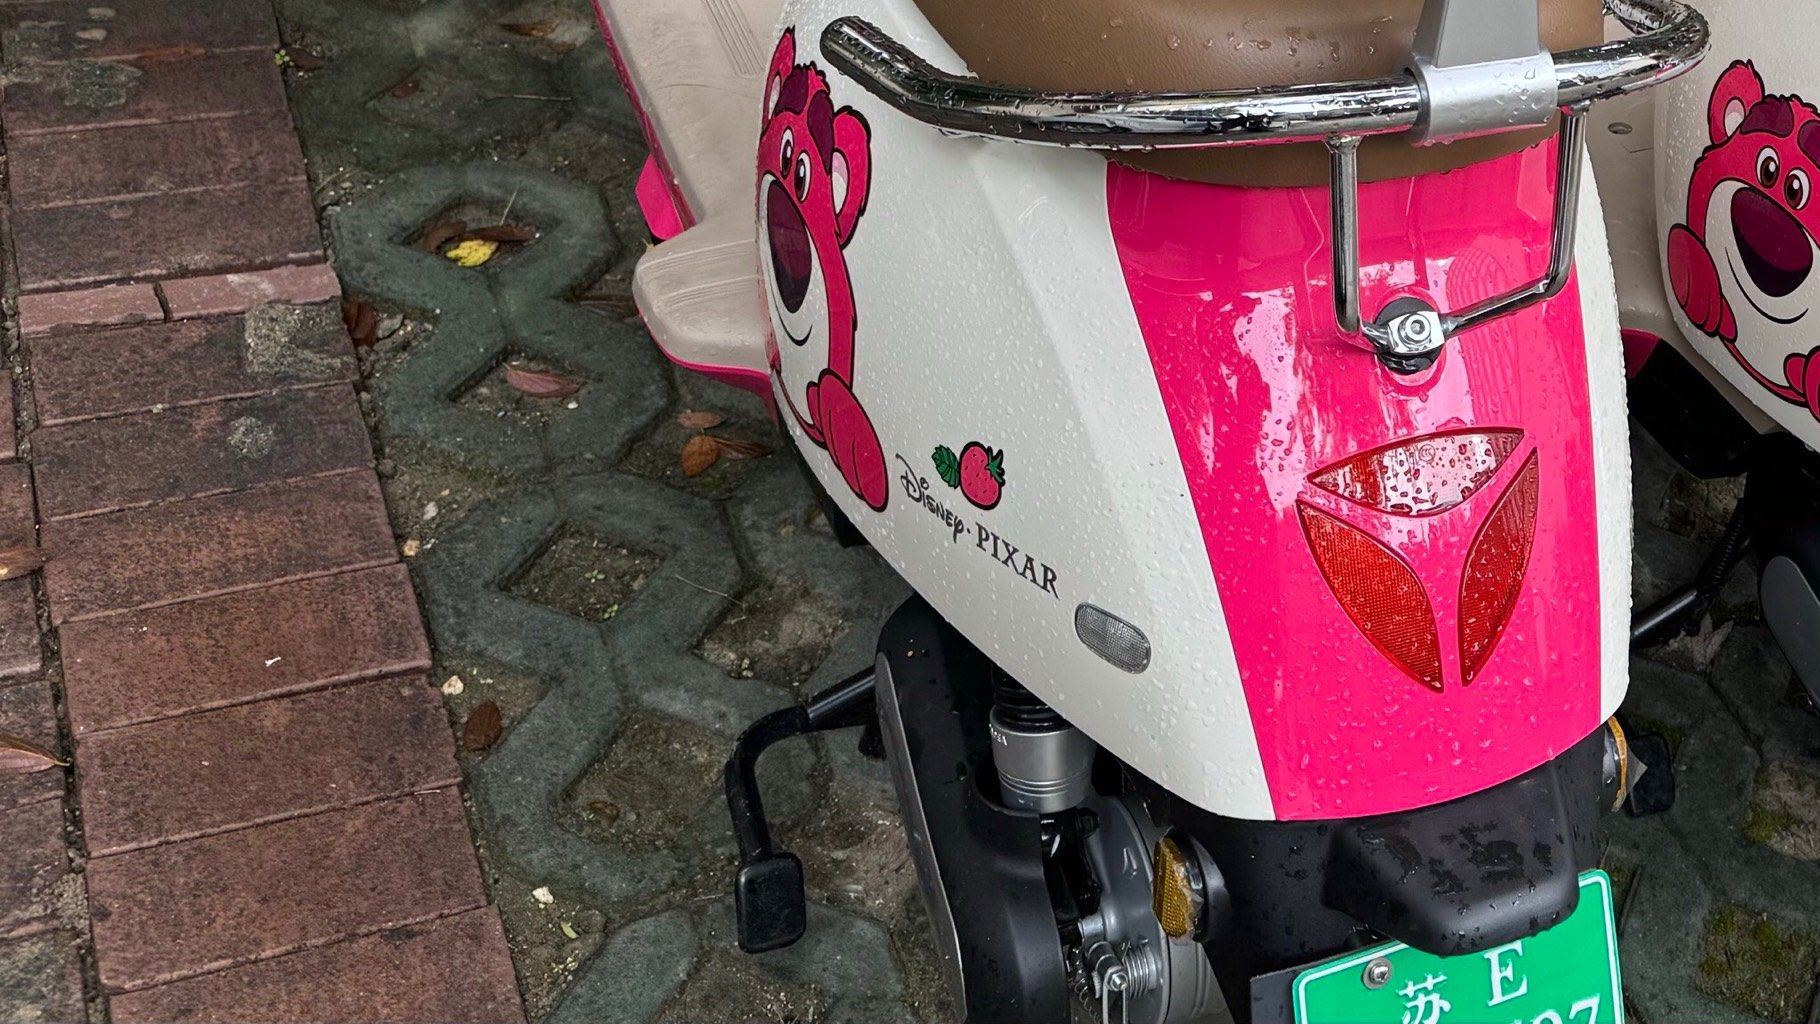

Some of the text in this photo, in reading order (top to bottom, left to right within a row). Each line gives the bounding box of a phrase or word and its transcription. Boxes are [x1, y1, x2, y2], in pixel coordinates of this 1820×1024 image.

[896, 453, 1059, 600] Disney PIXAR
[1396, 972, 1451, 1024] 苏
[1483, 939, 1528, 1007] E
